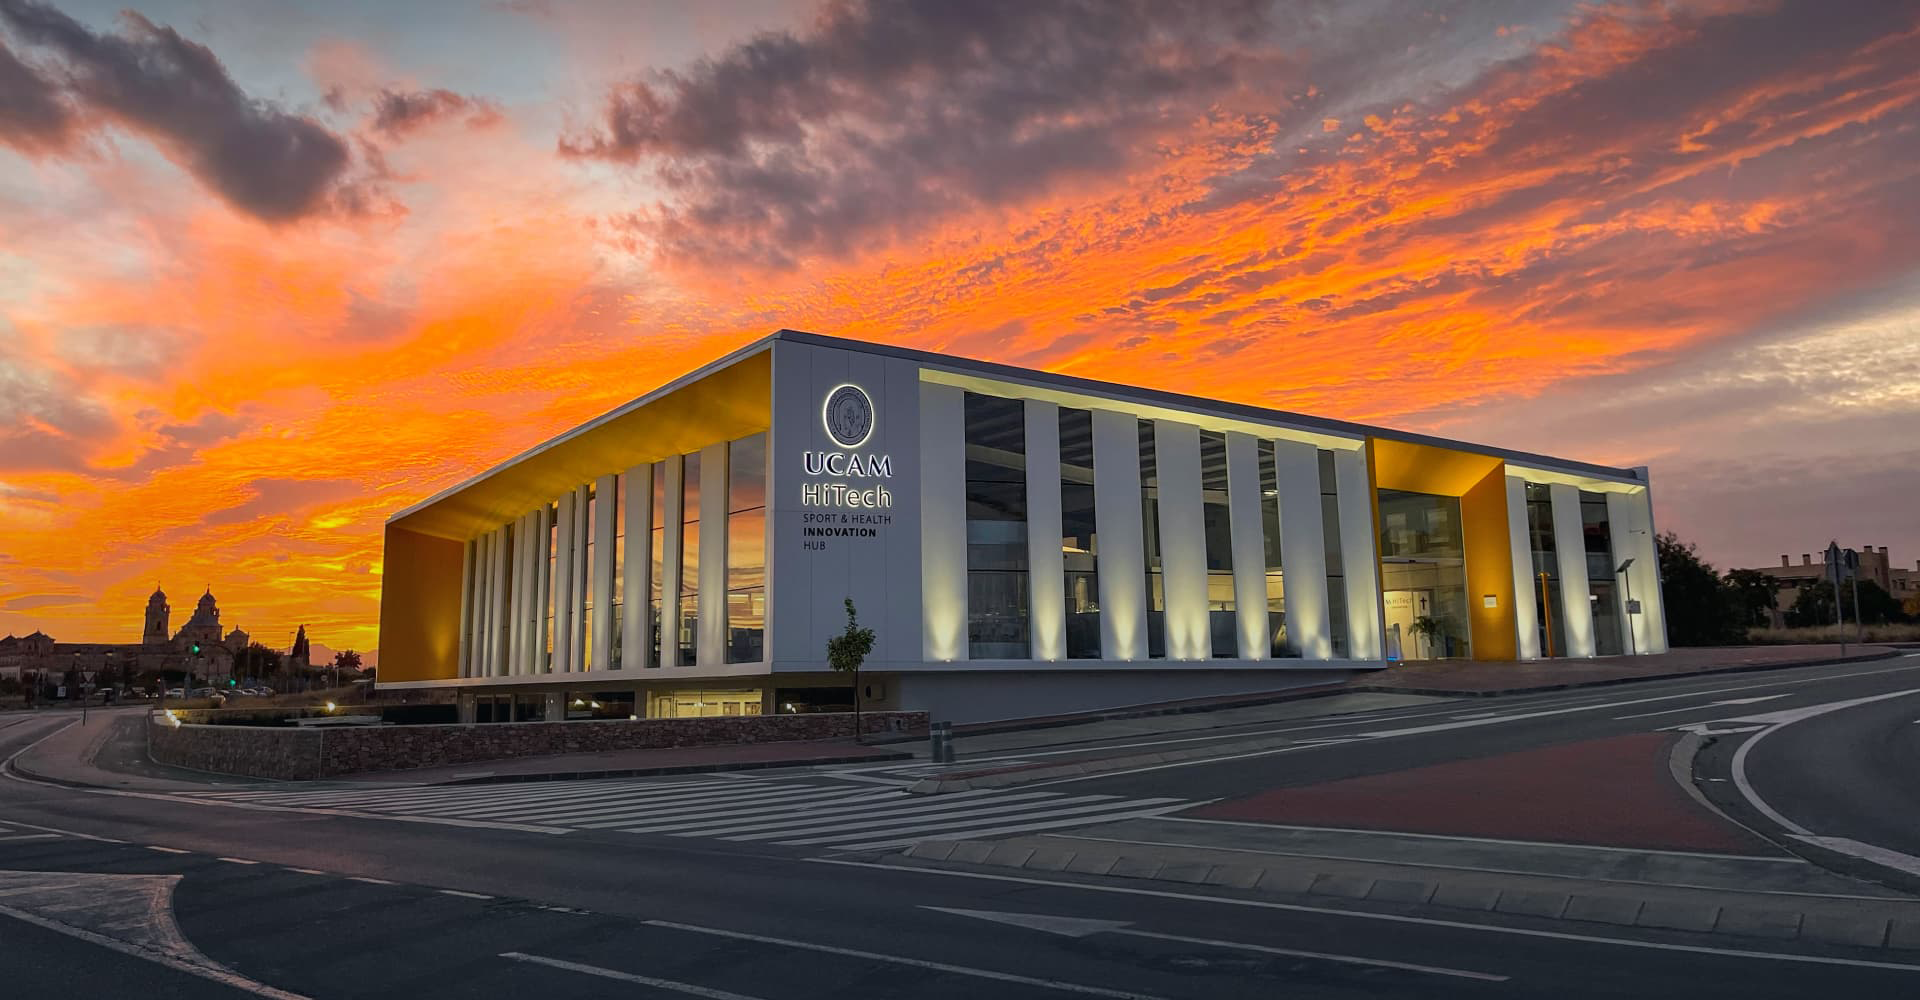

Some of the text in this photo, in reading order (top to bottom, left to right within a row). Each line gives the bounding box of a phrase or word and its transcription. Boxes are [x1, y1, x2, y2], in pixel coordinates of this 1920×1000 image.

[803, 452, 892, 477] UCAM
[803, 484, 891, 507] HiTech
[803, 513, 891, 525] SPORT & HEALTH
[804, 527, 876, 537] INNOVATION
[804, 541, 826, 550] HUB
